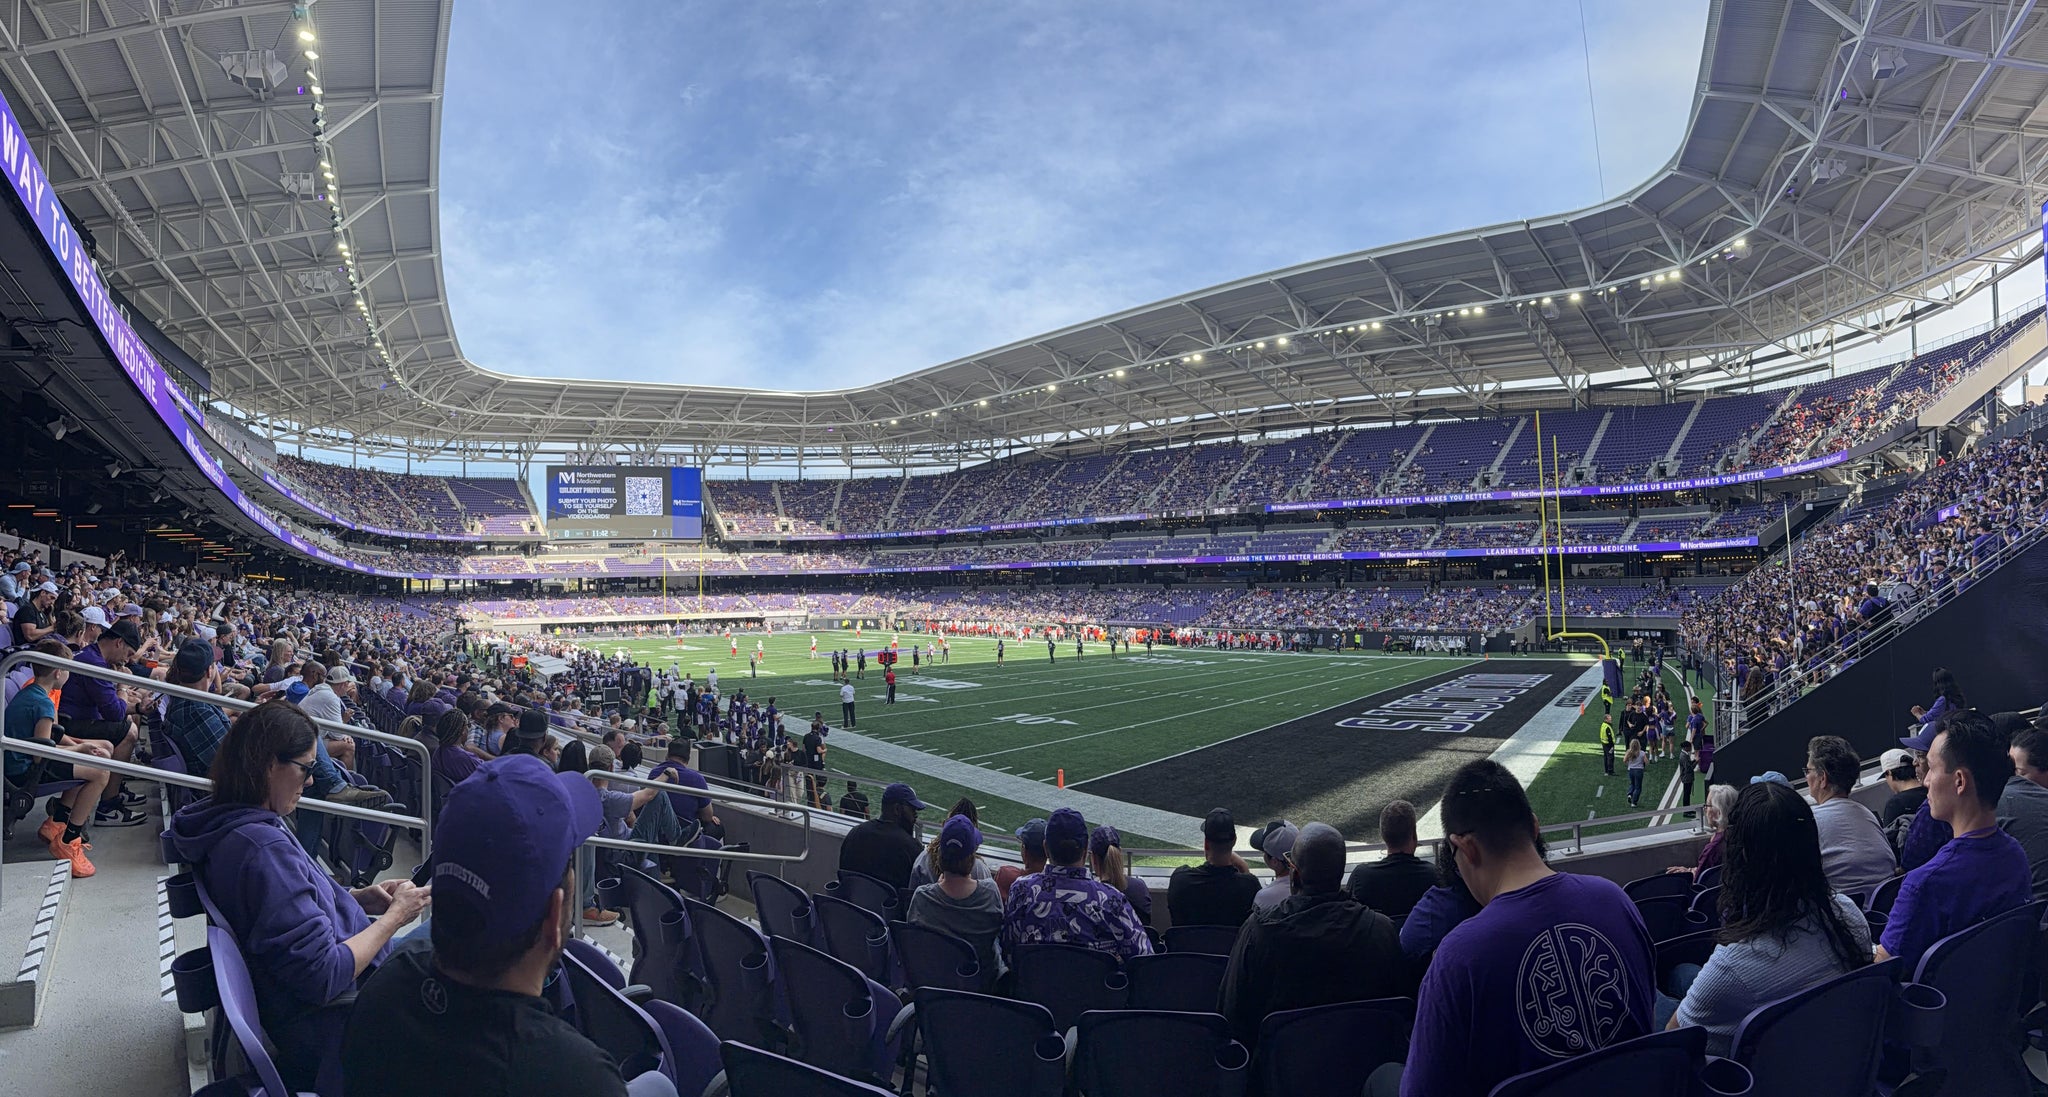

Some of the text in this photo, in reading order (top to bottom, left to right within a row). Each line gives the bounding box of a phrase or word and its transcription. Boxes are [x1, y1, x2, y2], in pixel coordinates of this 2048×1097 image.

[2, 110, 44, 216] WAY
[50, 201, 69, 261] TO
[74, 246, 115, 344] BETTER
[566, 453, 687, 467] RYAN FIELD
[1600, 485, 1620, 493] WHAT
[1623, 484, 1648, 492] MAKES
[1663, 481, 1692, 489] BETTER,
[1695, 477, 1719, 486] MAKES
[1722, 475, 1736, 483] YOU
[1361, 498, 1383, 506] MAKES
[564, 530, 570, 538] 0
[653, 529, 658, 537] 7
[1601, 544, 1640, 552] MEDICINE.
[1688, 541, 1726, 549] Northwestern
[991, 713, 1056, 725] 10
[20, 799, 26, 808] 11
